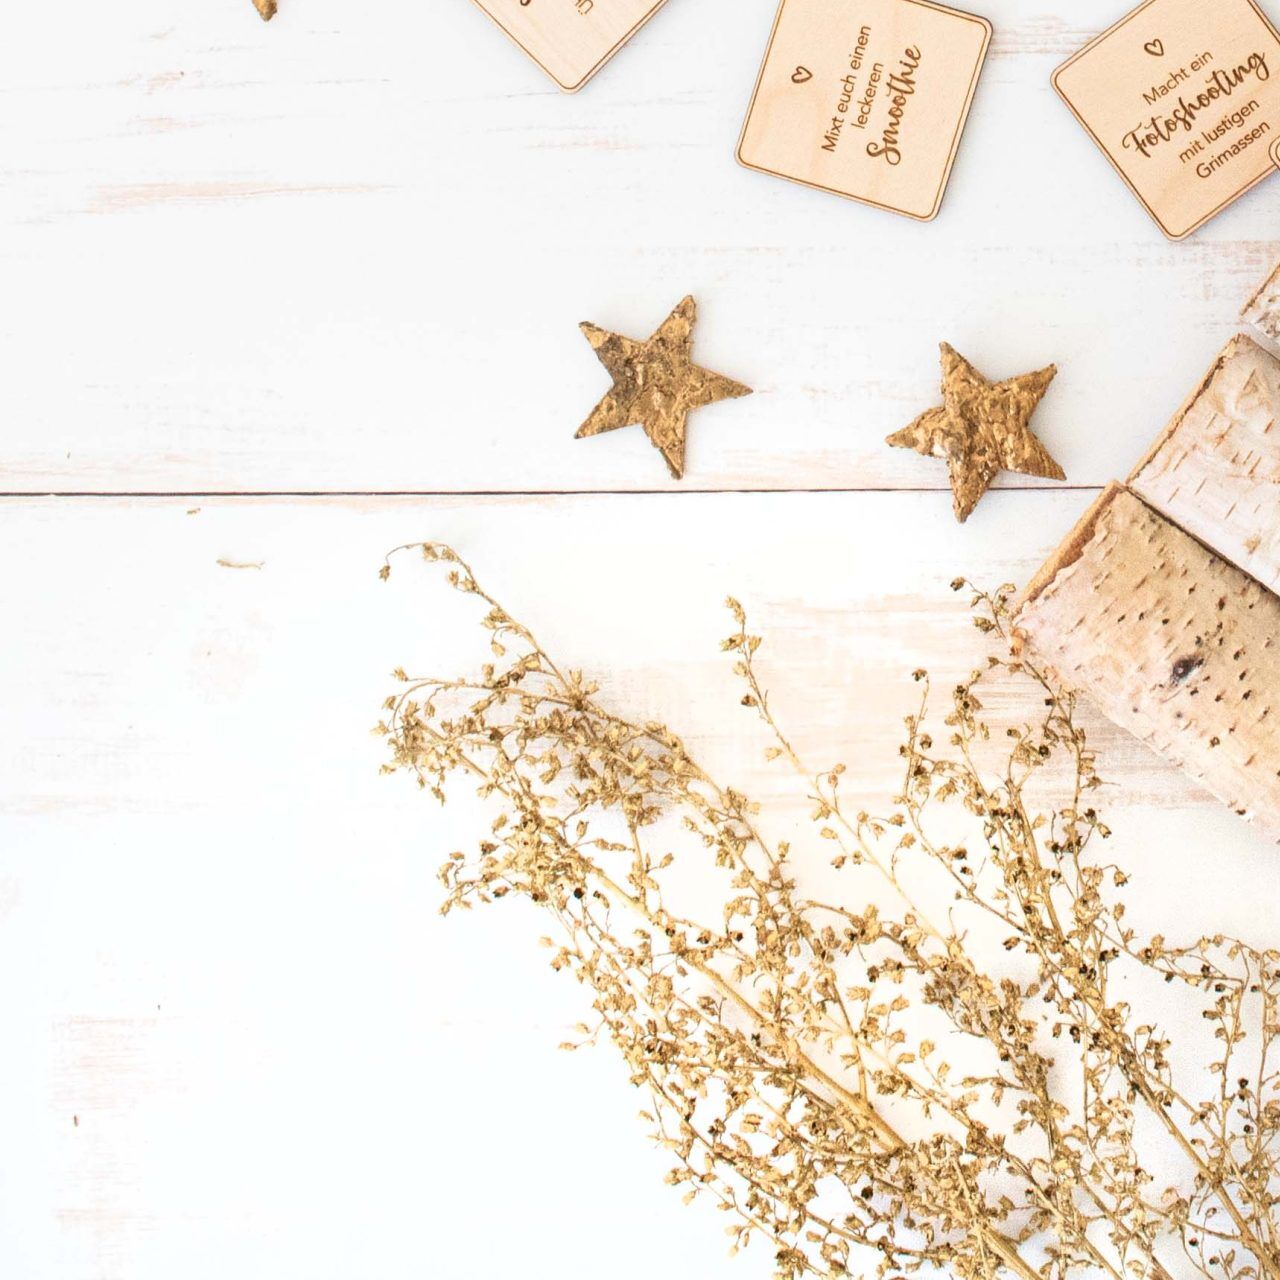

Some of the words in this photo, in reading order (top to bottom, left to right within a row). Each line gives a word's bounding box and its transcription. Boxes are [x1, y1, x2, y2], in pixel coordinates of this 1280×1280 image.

[820, 115, 845, 153] Mixt
[837, 74, 857, 114] euch
[848, 25, 872, 71] einen
[850, 62, 884, 130] leckeren
[865, 44, 922, 166] Smoothie
[1121, 52, 1270, 159] Fotoshooting
[1142, 67, 1191, 106] Macht
[1190, 51, 1214, 72] ein
[1178, 139, 1206, 164] mit
[1200, 99, 1260, 145] lustigen
[1195, 121, 1271, 179] Grimassen
